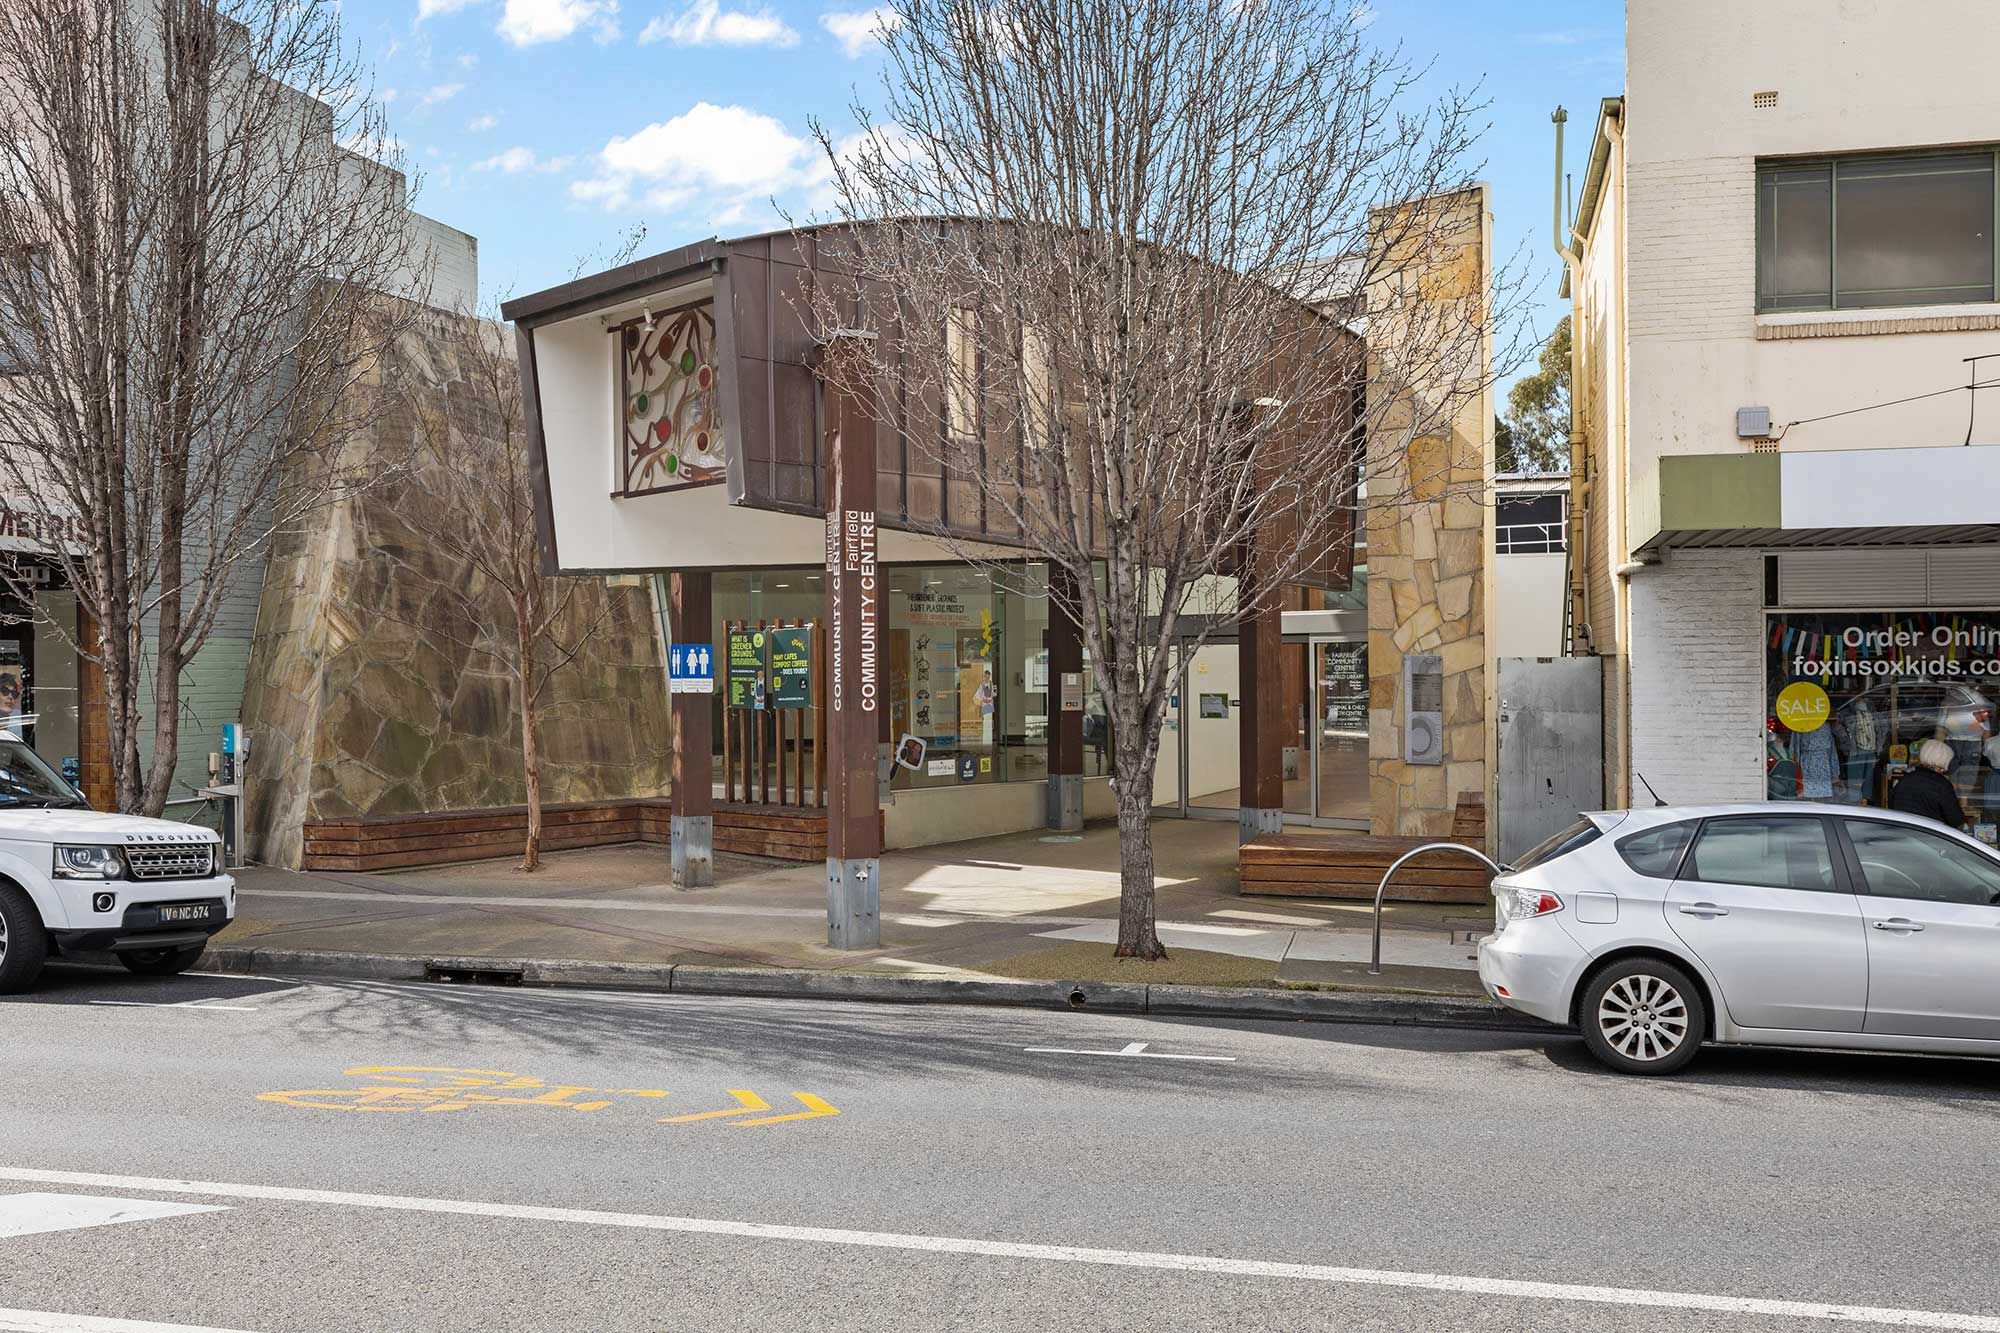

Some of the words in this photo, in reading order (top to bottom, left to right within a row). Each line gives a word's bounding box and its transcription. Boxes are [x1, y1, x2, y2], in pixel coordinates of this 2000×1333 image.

[833, 511, 841, 591] CENTRE
[845, 510, 859, 571] Fairfield
[861, 511, 876, 591] CENTRE
[833, 594, 842, 712] COMMUNITY
[861, 594, 876, 712] COMMUNITY
[1793, 655, 2000, 676] foxinsoxkids.co
[1843, 626, 1924, 647] Order
[1781, 697, 1826, 715] SALE
